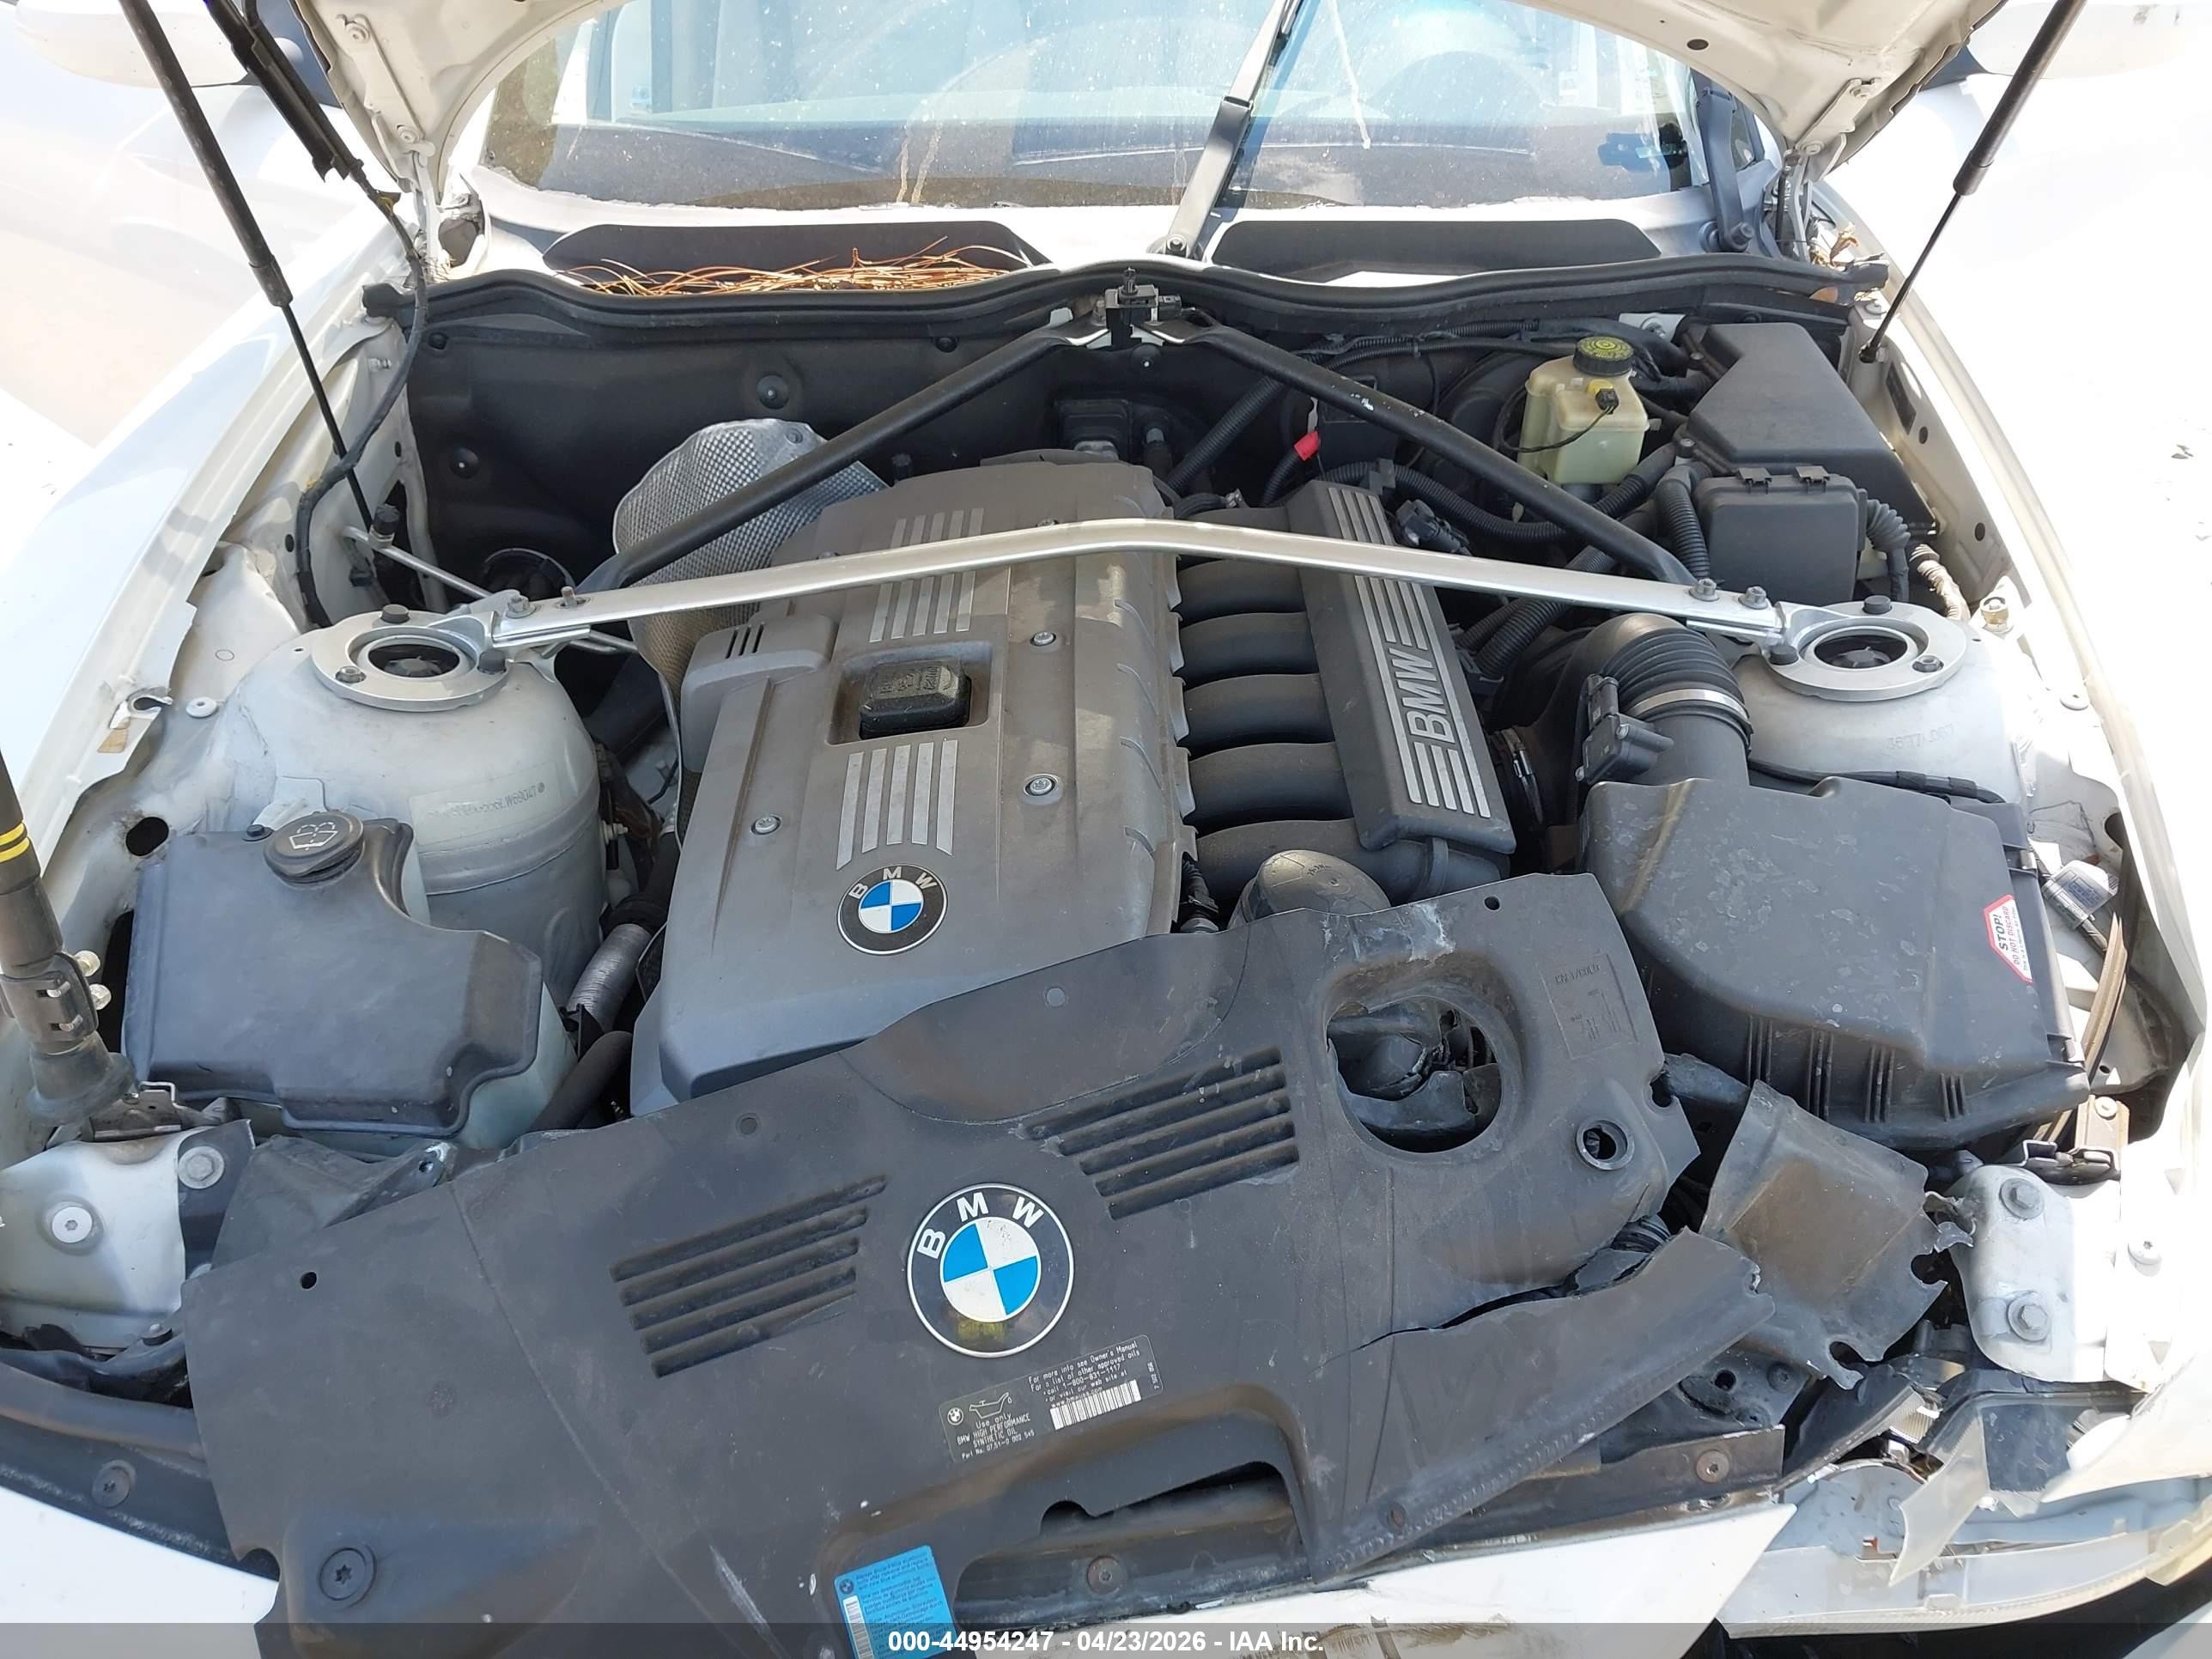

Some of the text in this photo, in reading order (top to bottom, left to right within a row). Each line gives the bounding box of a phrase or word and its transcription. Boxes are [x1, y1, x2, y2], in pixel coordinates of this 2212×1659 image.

[1389, 647, 1455, 744] BMW
[848, 866, 938, 900] BMW
[1993, 914, 2008, 951] STOP!
[2002, 906, 2021, 965] DO NOT DISCARD
[916, 1192, 1043, 1259] BMW
[1029, 1376, 1039, 1385] For
[1043, 1370, 1058, 1380] more
[1060, 1364, 1073, 1373] info
[1091, 1349, 1114, 1363] Owner's
[1116, 1340, 1138, 1354] Manual
[1030, 1383, 1042, 1392] For
[1052, 1375, 1064, 1385] list
[1067, 1370, 1074, 1380] of
[1078, 1365, 1093, 1376] other
[1097, 1353, 1125, 1370] approved
[1127, 1350, 1139, 1358] oils
[1062, 1363, 1121, 1389] 1-800-831-1117
[1060, 1387, 1073, 1398] visit
[1091, 1378, 1103, 1388] web
[957, 1413, 1030, 1445] BMW HIGH PERFORMANCE
[973, 1426, 1018, 1449] SYNTHETIC OIL
[975, 1412, 1012, 1430] Use only
